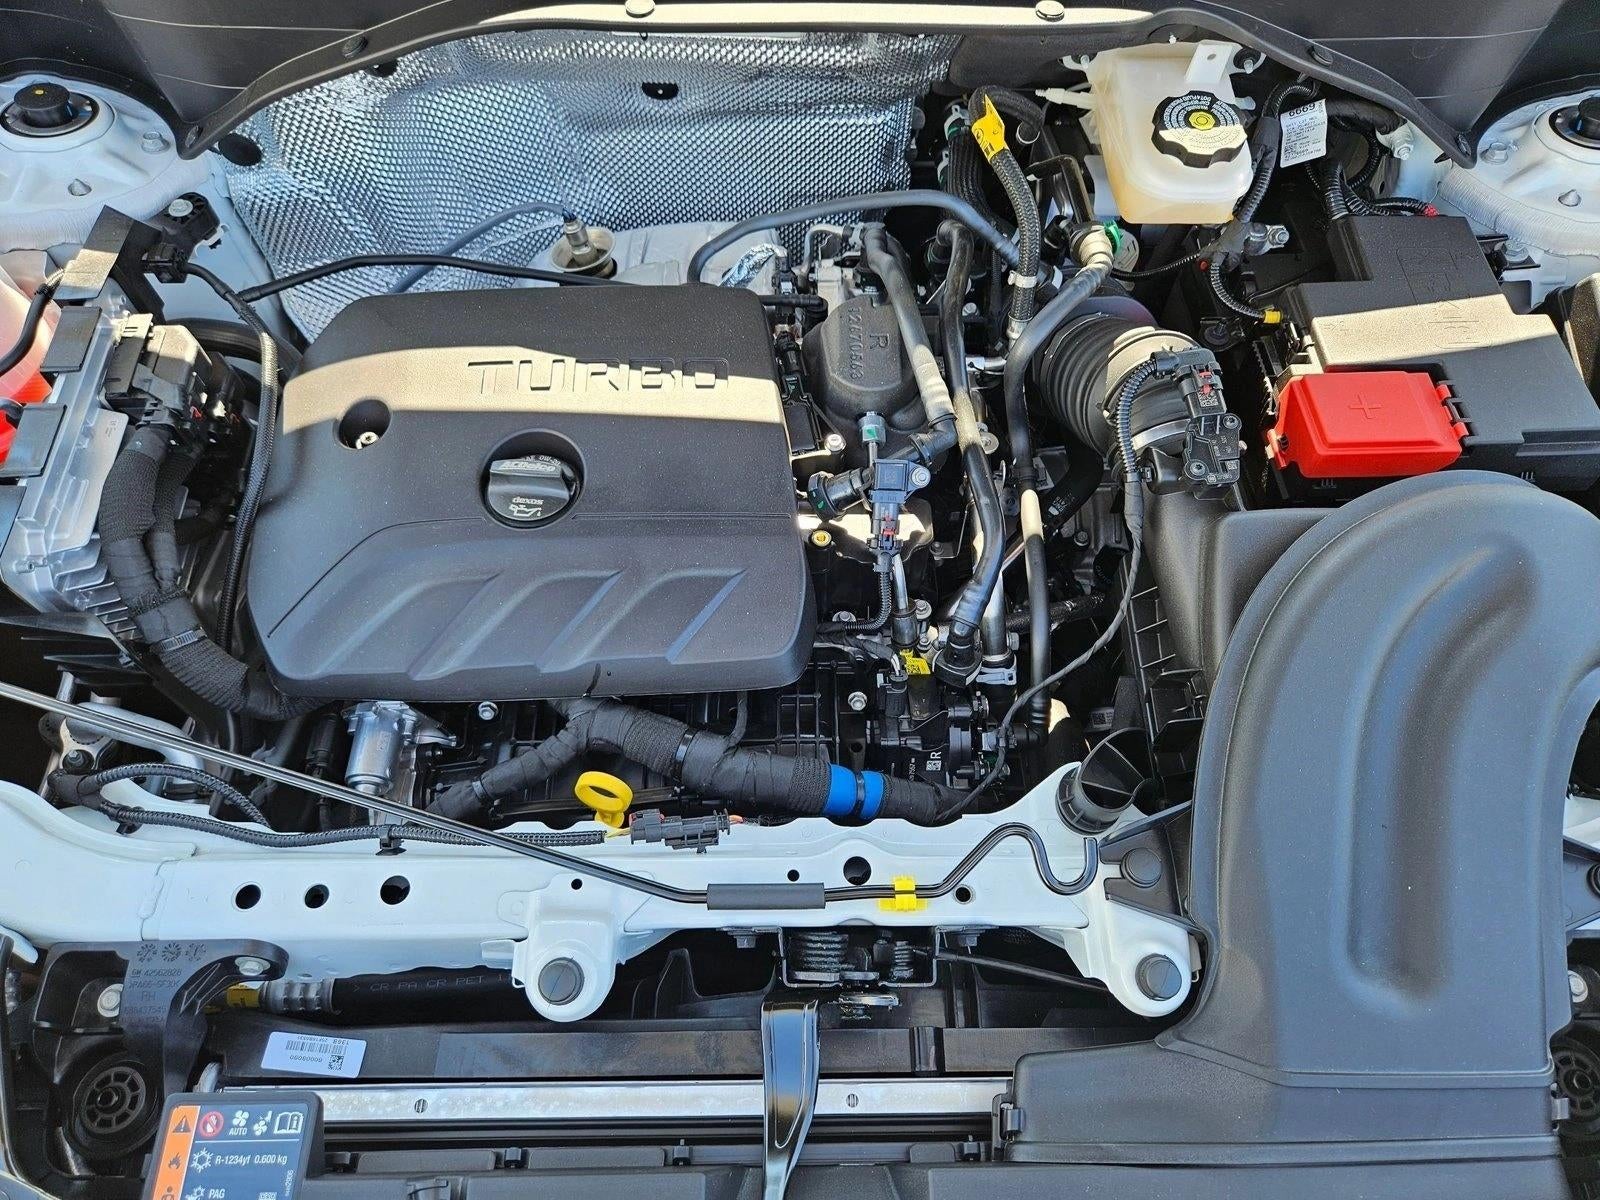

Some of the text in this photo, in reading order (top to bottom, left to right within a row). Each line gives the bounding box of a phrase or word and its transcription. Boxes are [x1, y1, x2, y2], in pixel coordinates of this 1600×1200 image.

[870, 333, 890, 350] R
[467, 357, 730, 393] TURBO
[512, 496, 544, 505] dexos
[930, 751, 942, 759] R
[456, 975, 484, 986] PET
[228, 1127, 248, 1136] AUTO
[215, 1154, 288, 1167] R-1234yf 0.600 kg
[208, 1188, 226, 1199] PAG
